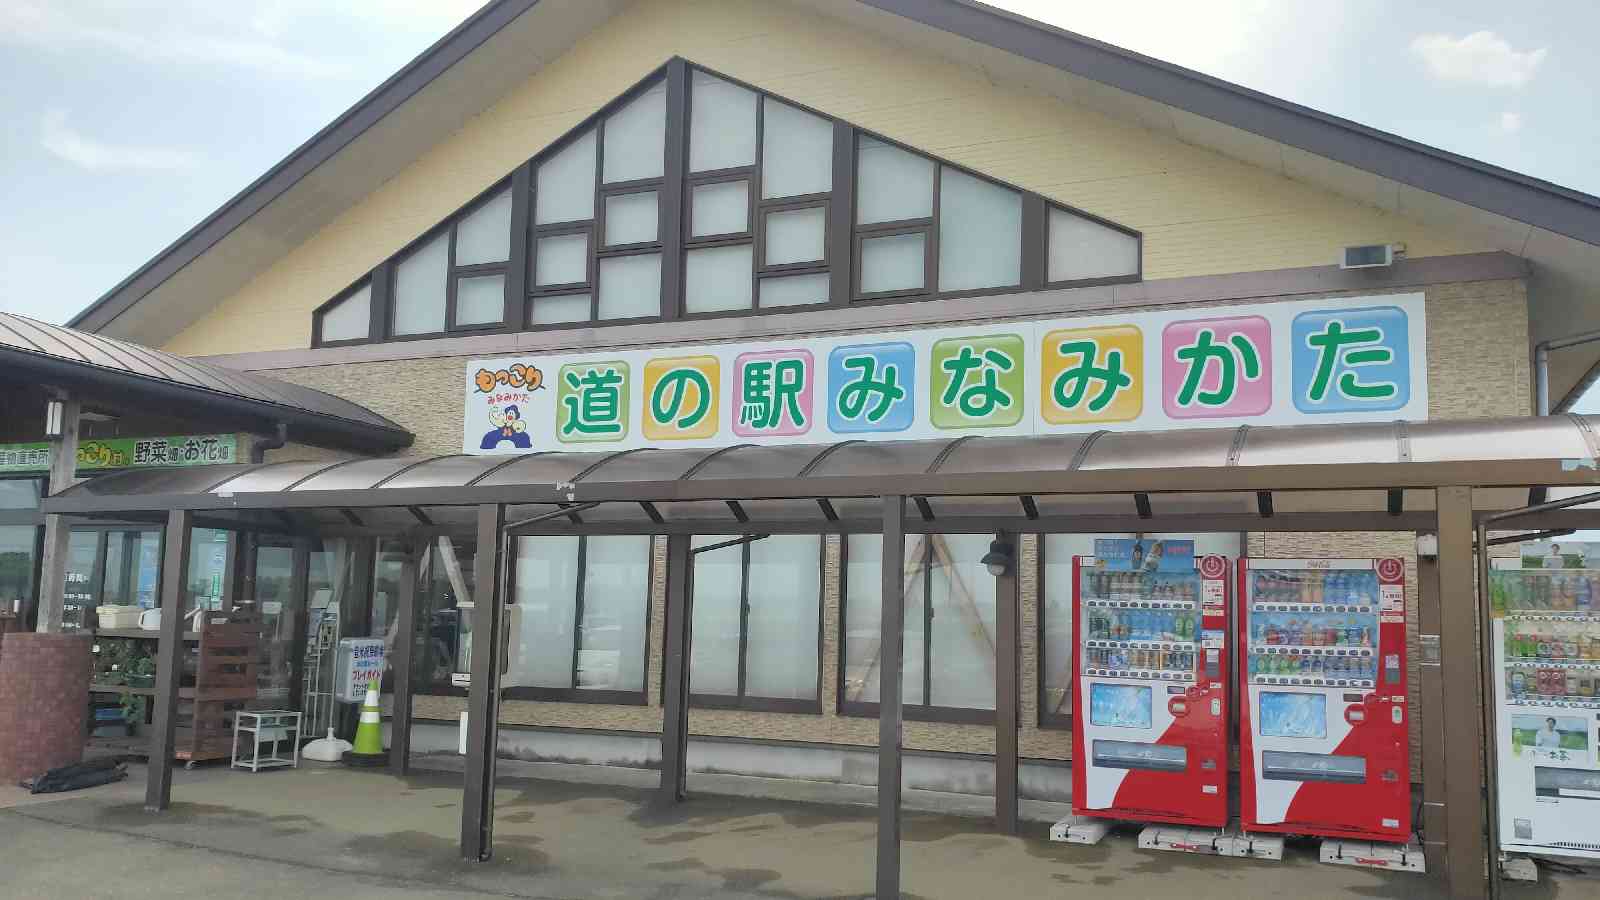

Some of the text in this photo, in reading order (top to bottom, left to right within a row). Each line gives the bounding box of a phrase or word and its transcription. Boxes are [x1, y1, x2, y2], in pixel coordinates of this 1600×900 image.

[561, 321, 1397, 434] 道の駅みなみかた
